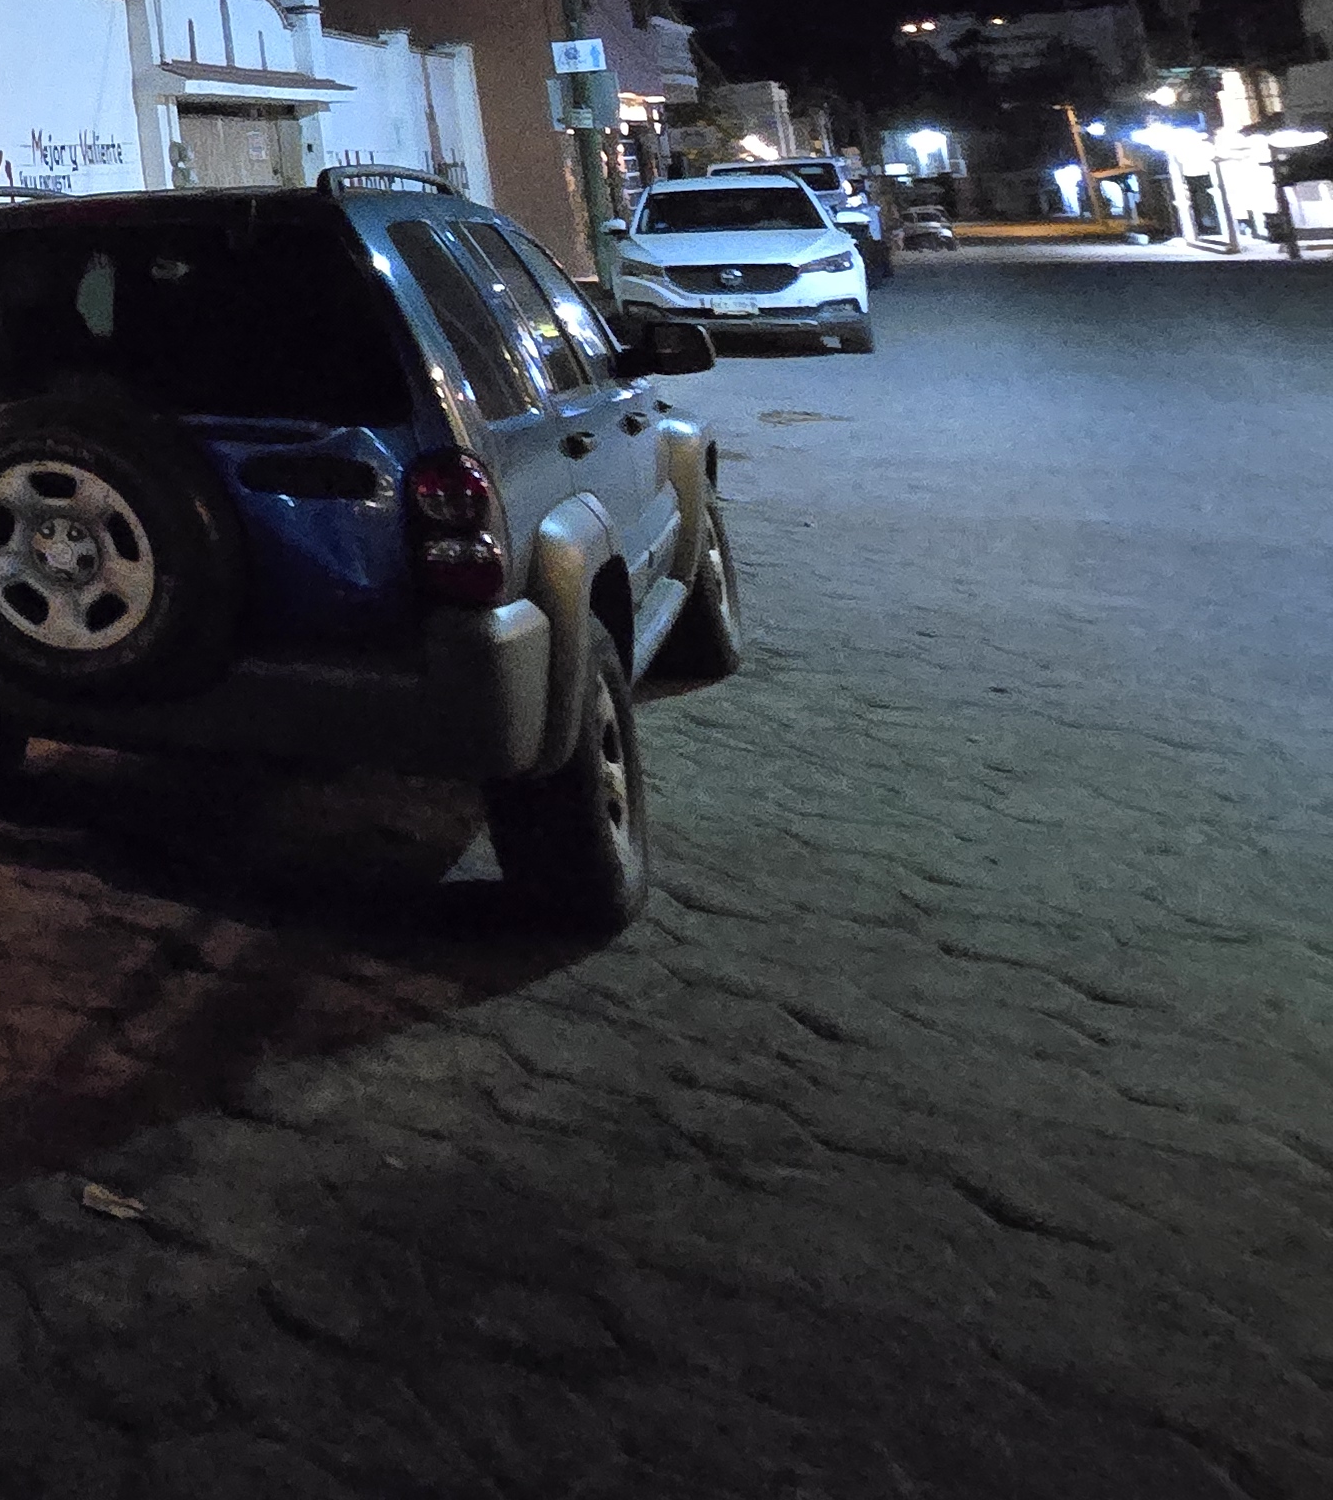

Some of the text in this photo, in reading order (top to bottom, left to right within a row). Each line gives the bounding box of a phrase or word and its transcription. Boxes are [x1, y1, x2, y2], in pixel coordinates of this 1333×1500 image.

[31, 128, 123, 172] Mejor y Valiente
